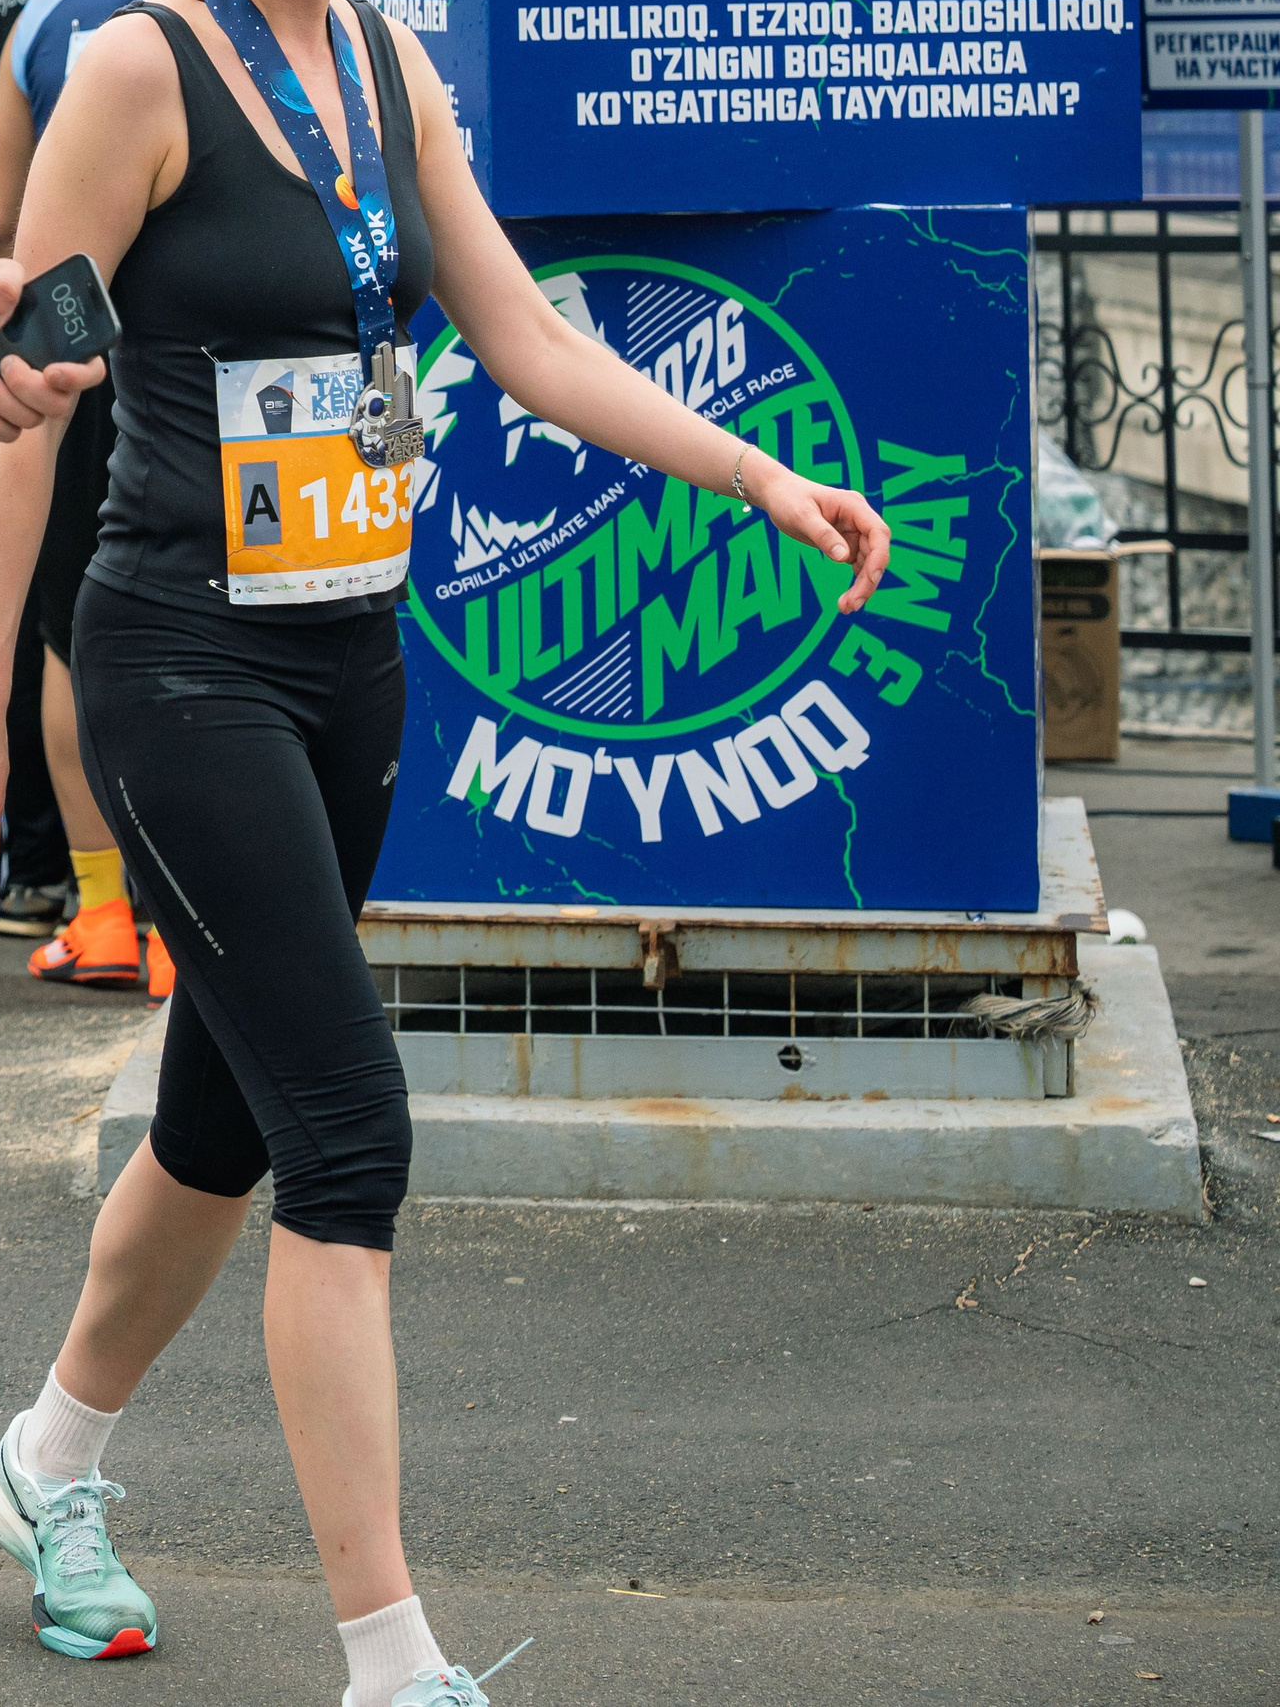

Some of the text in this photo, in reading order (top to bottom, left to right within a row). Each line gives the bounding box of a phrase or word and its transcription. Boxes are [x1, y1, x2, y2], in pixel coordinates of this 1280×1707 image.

[519, 5, 717, 41] KUCHLIROQ.
[728, 2, 862, 39] TEZROQ.
[785, 41, 1027, 80] BOSHQALARGA
[1175, 59, 1201, 79] НА
[827, 82, 1079, 119] TAYYORMISAN?
[51, 283, 89, 345] 09:51
[435, 562, 511, 600] GORILLA
[510, 507, 588, 568] ULTIMATE
[746, 362, 797, 401] RACE
[244, 484, 279, 525] A
[829, 440, 969, 705] 3 MAY
